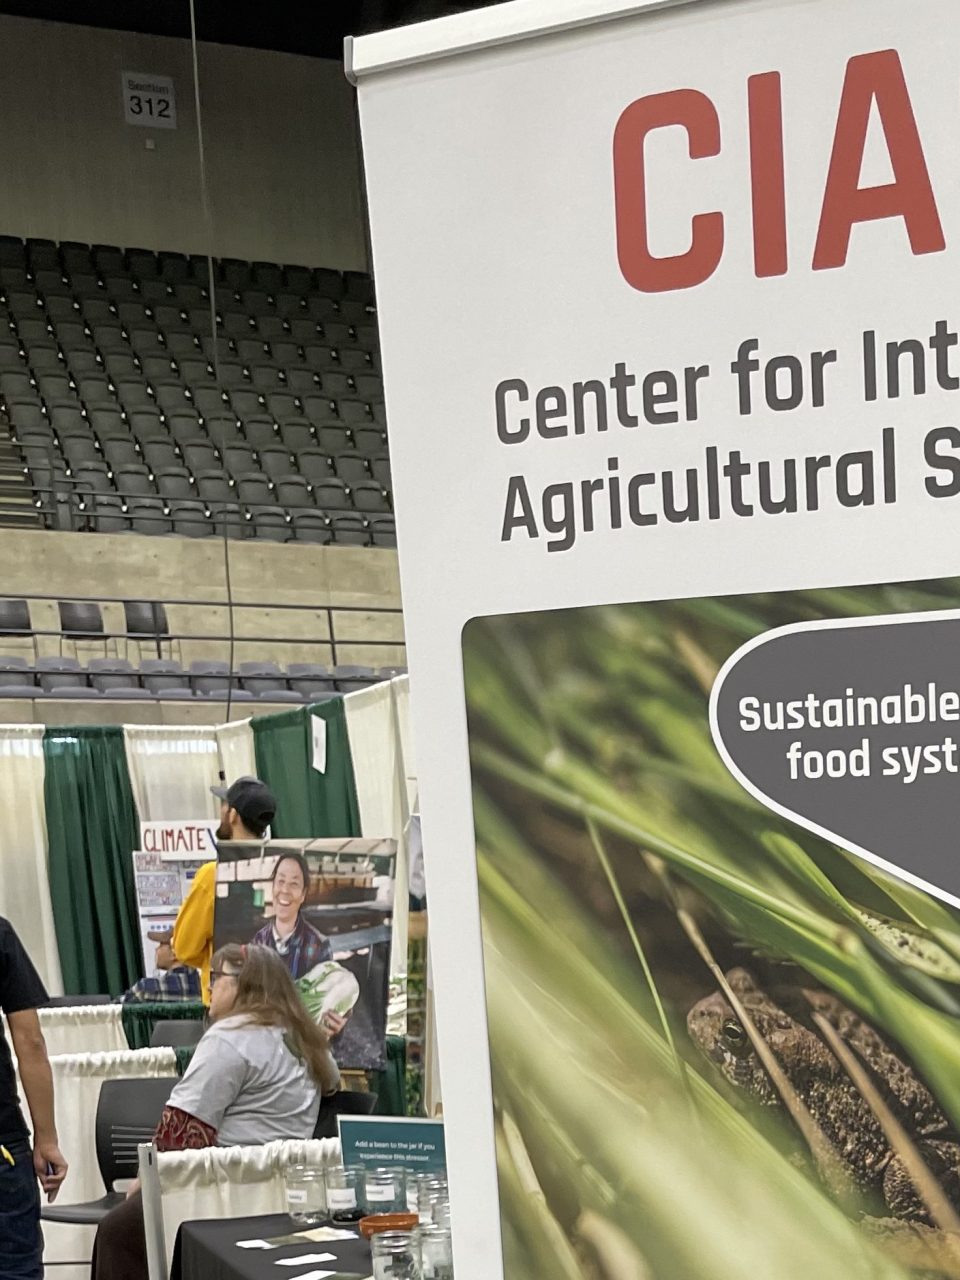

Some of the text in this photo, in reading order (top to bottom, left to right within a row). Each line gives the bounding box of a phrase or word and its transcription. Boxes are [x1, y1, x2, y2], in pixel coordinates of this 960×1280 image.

[130, 96, 171, 118] 312
[494, 362, 709, 445] Center
[731, 339, 837, 416] for
[501, 429, 897, 553] Agricultural
[738, 683, 960, 732] Sustainable
[786, 740, 870, 780] food
[144, 827, 206, 852] CLIMATE
